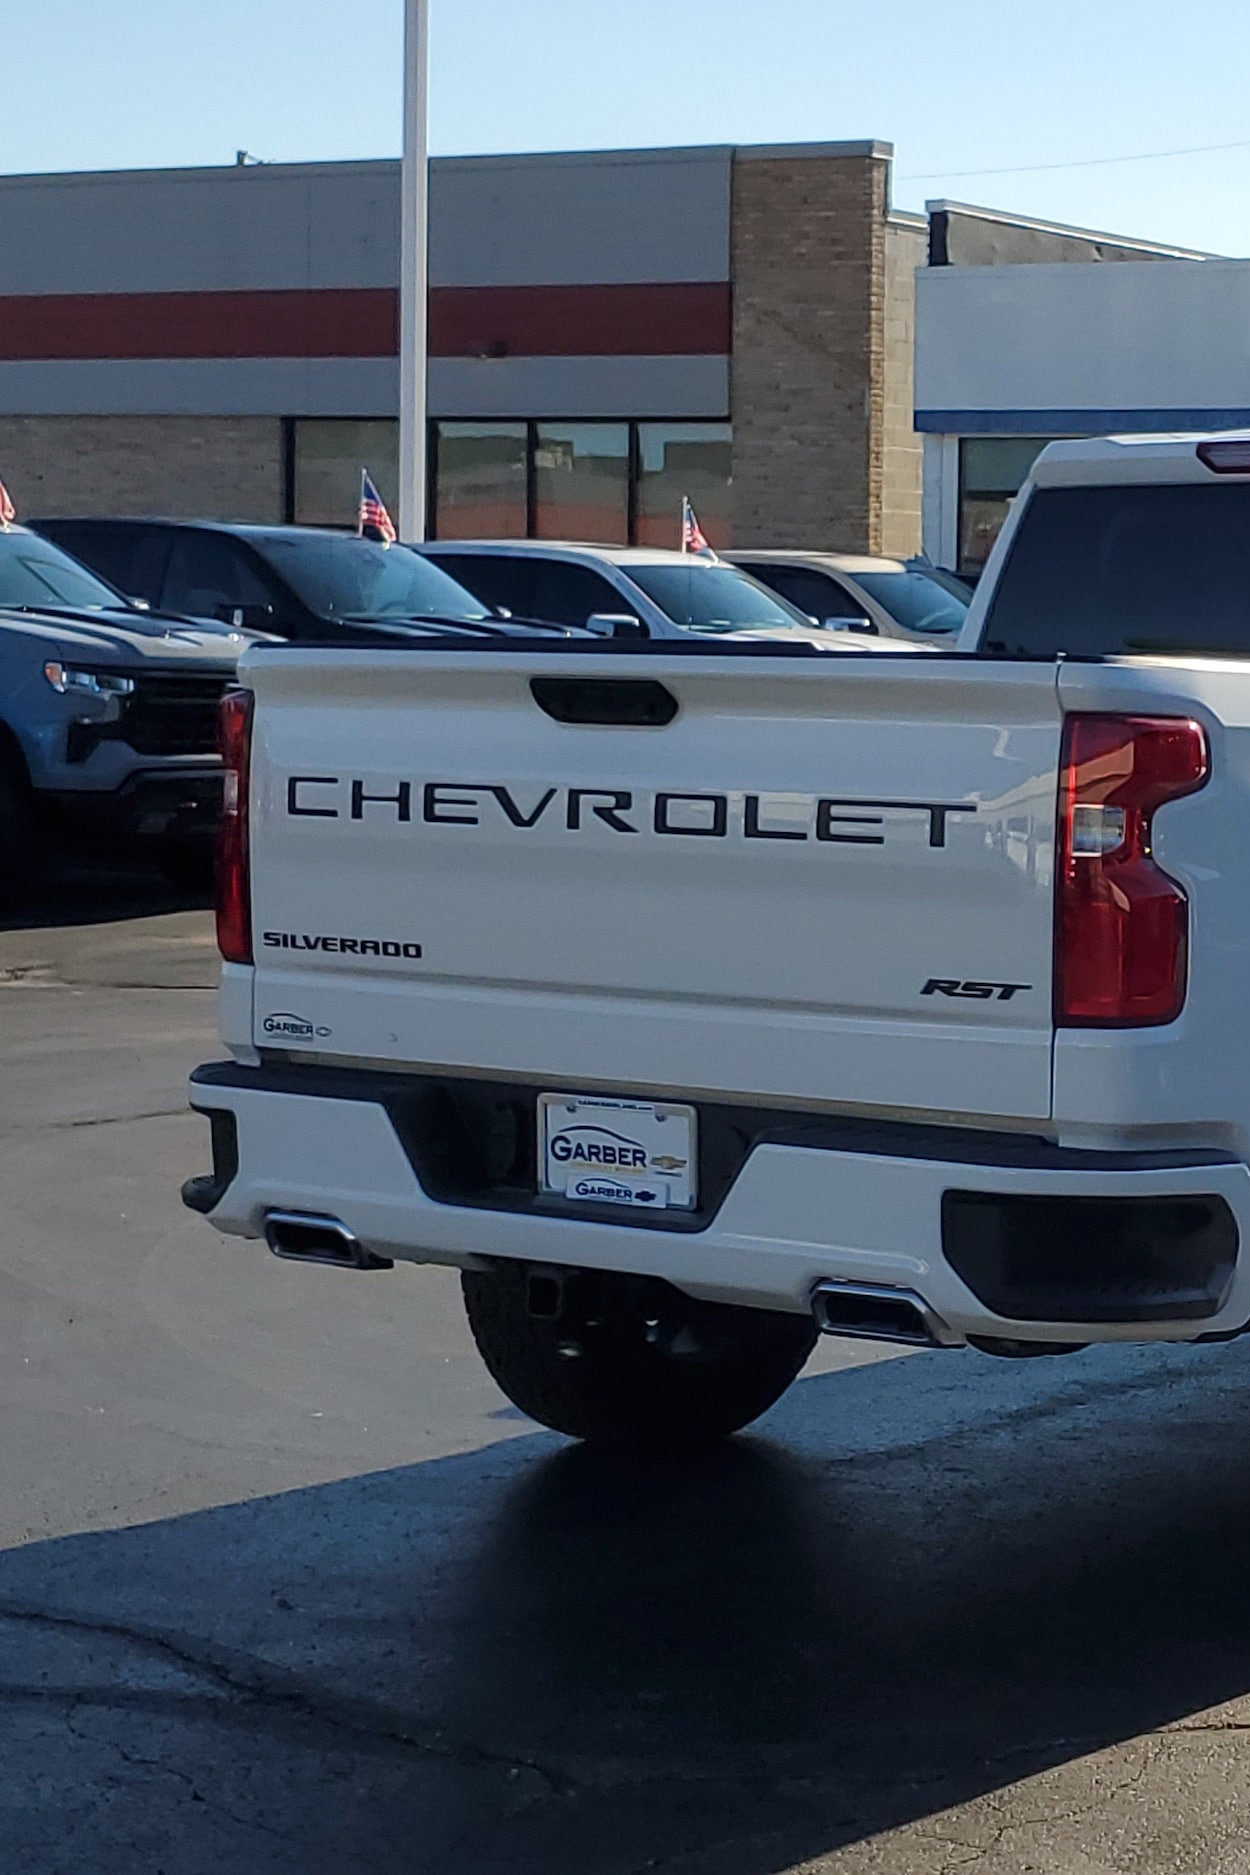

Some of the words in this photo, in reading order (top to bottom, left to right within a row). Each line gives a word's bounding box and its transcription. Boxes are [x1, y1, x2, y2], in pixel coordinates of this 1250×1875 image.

[287, 776, 977, 848] CHEVROLET
[264, 932, 422, 959] SILVERADO
[920, 978, 1033, 1001] RST
[263, 1017, 314, 1035] GARBER
[552, 1136, 647, 1168] GARBER
[576, 1183, 633, 1200] GARBER
